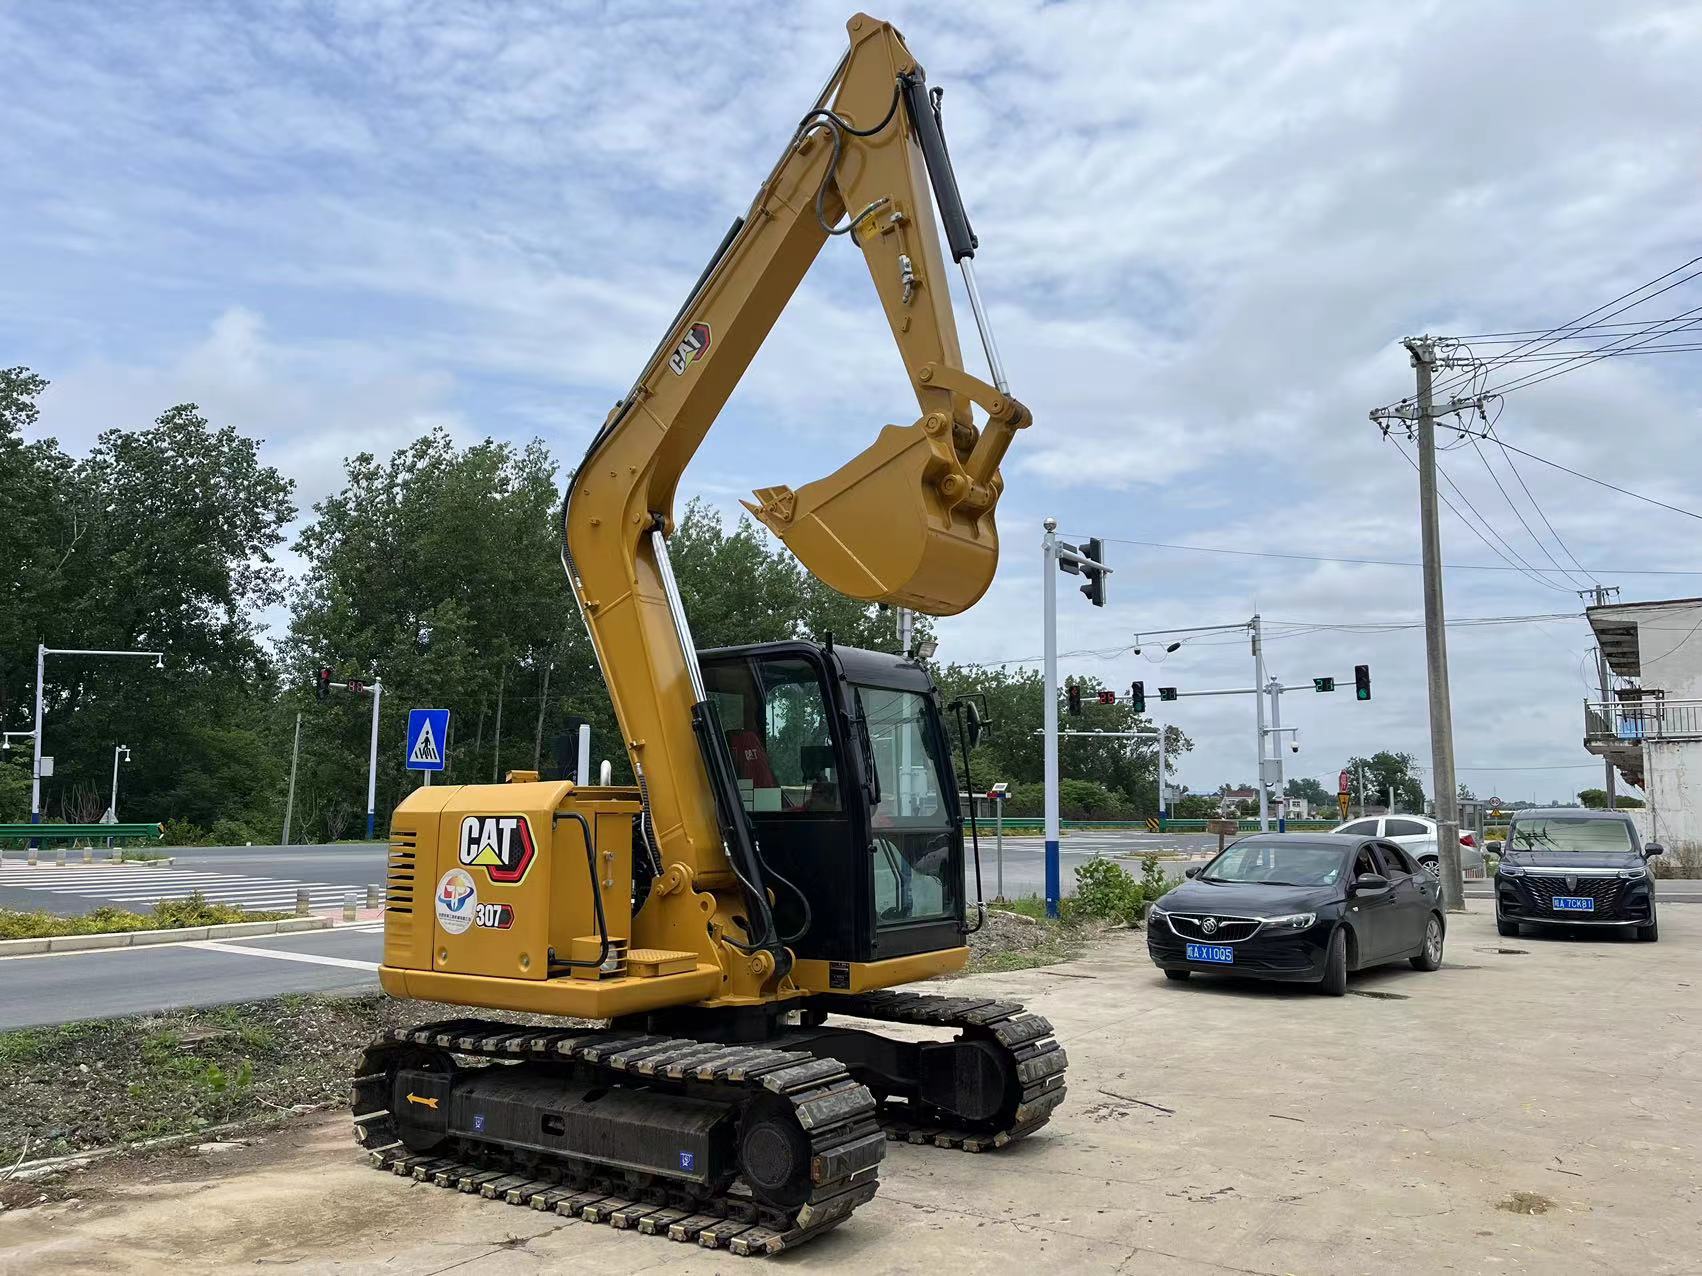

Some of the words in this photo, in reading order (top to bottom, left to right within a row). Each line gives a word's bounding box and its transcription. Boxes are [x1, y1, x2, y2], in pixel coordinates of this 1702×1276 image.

[668, 329, 702, 376] CAT
[460, 816, 517, 865] CAT
[476, 904, 501, 926] 307
